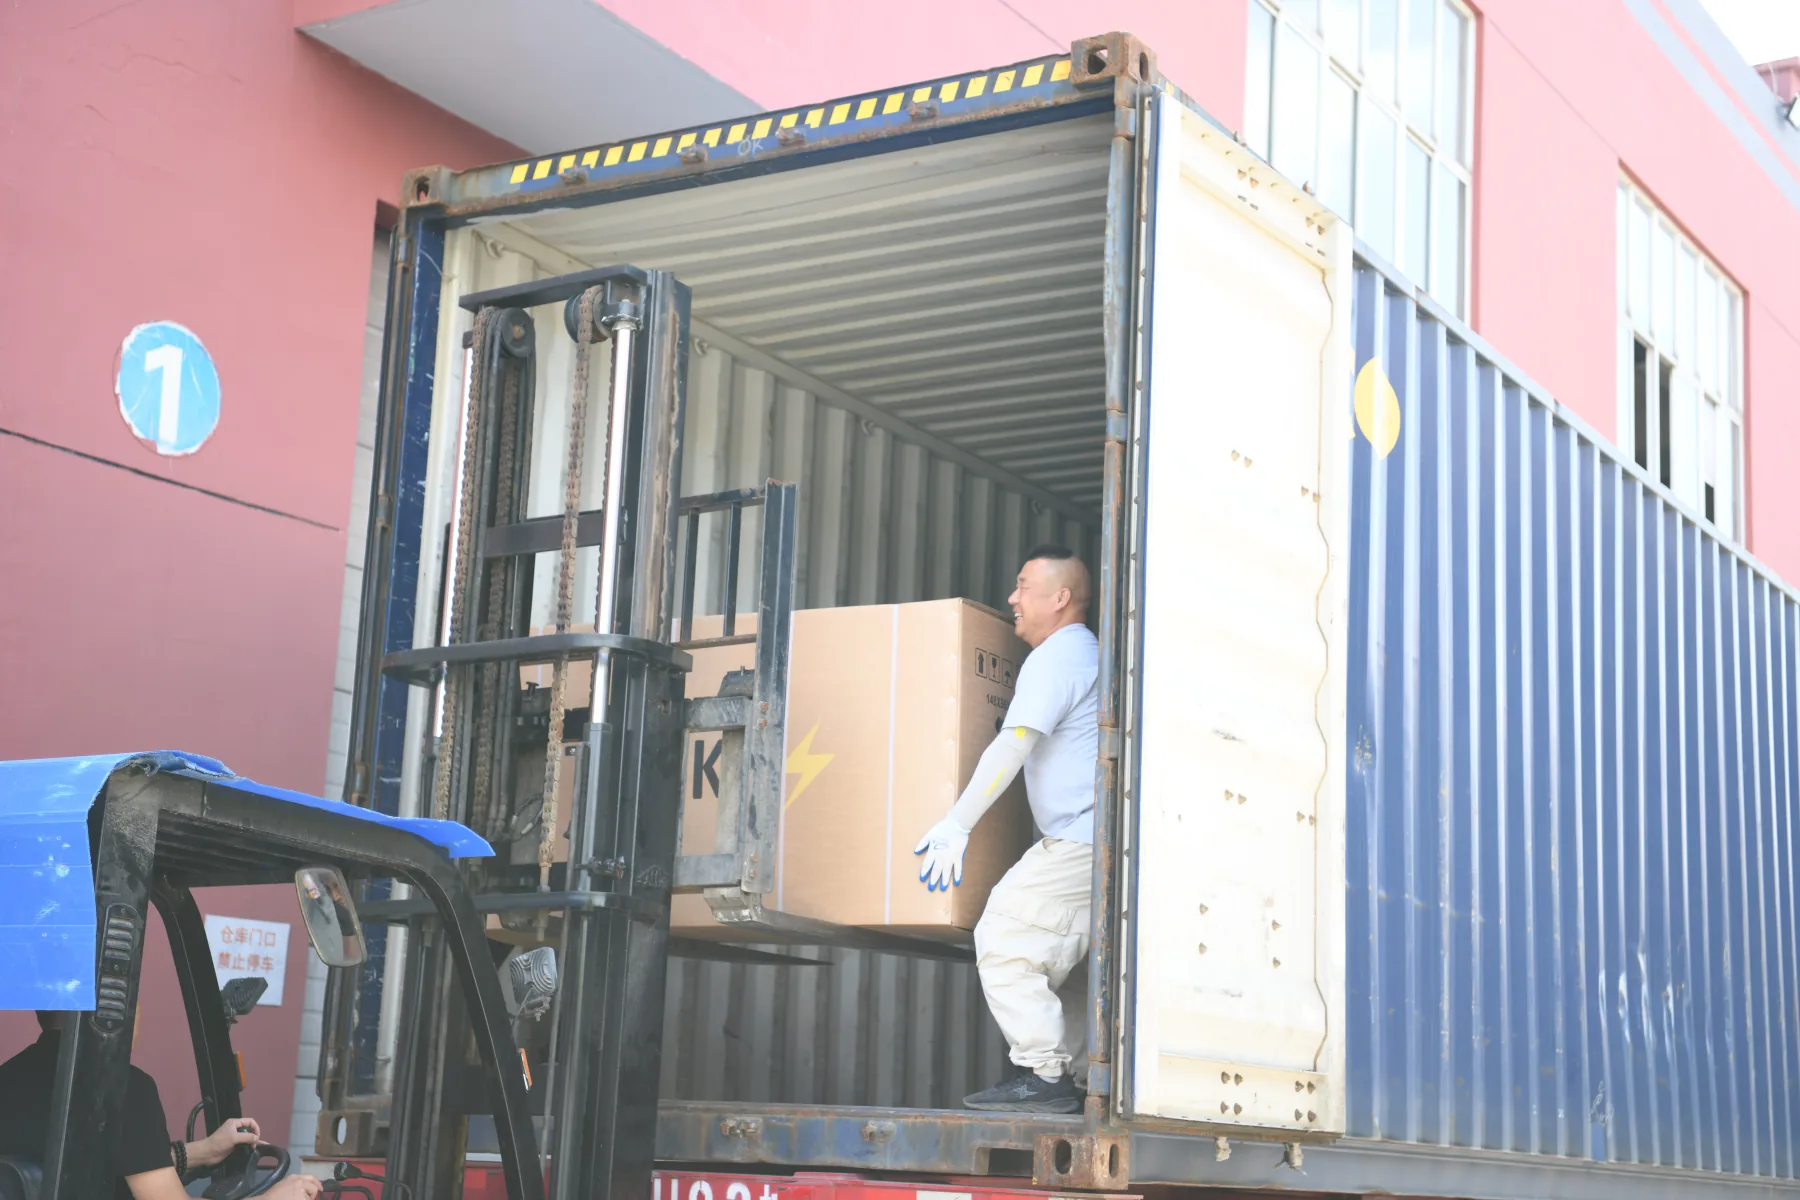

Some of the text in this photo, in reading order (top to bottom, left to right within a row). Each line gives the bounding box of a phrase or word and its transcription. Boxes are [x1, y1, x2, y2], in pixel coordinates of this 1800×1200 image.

[737, 135, 764, 156] OK
[144, 344, 184, 446] 1
[220, 925, 276, 948] 仓库门口
[217, 951, 274, 973] 禁止停车
